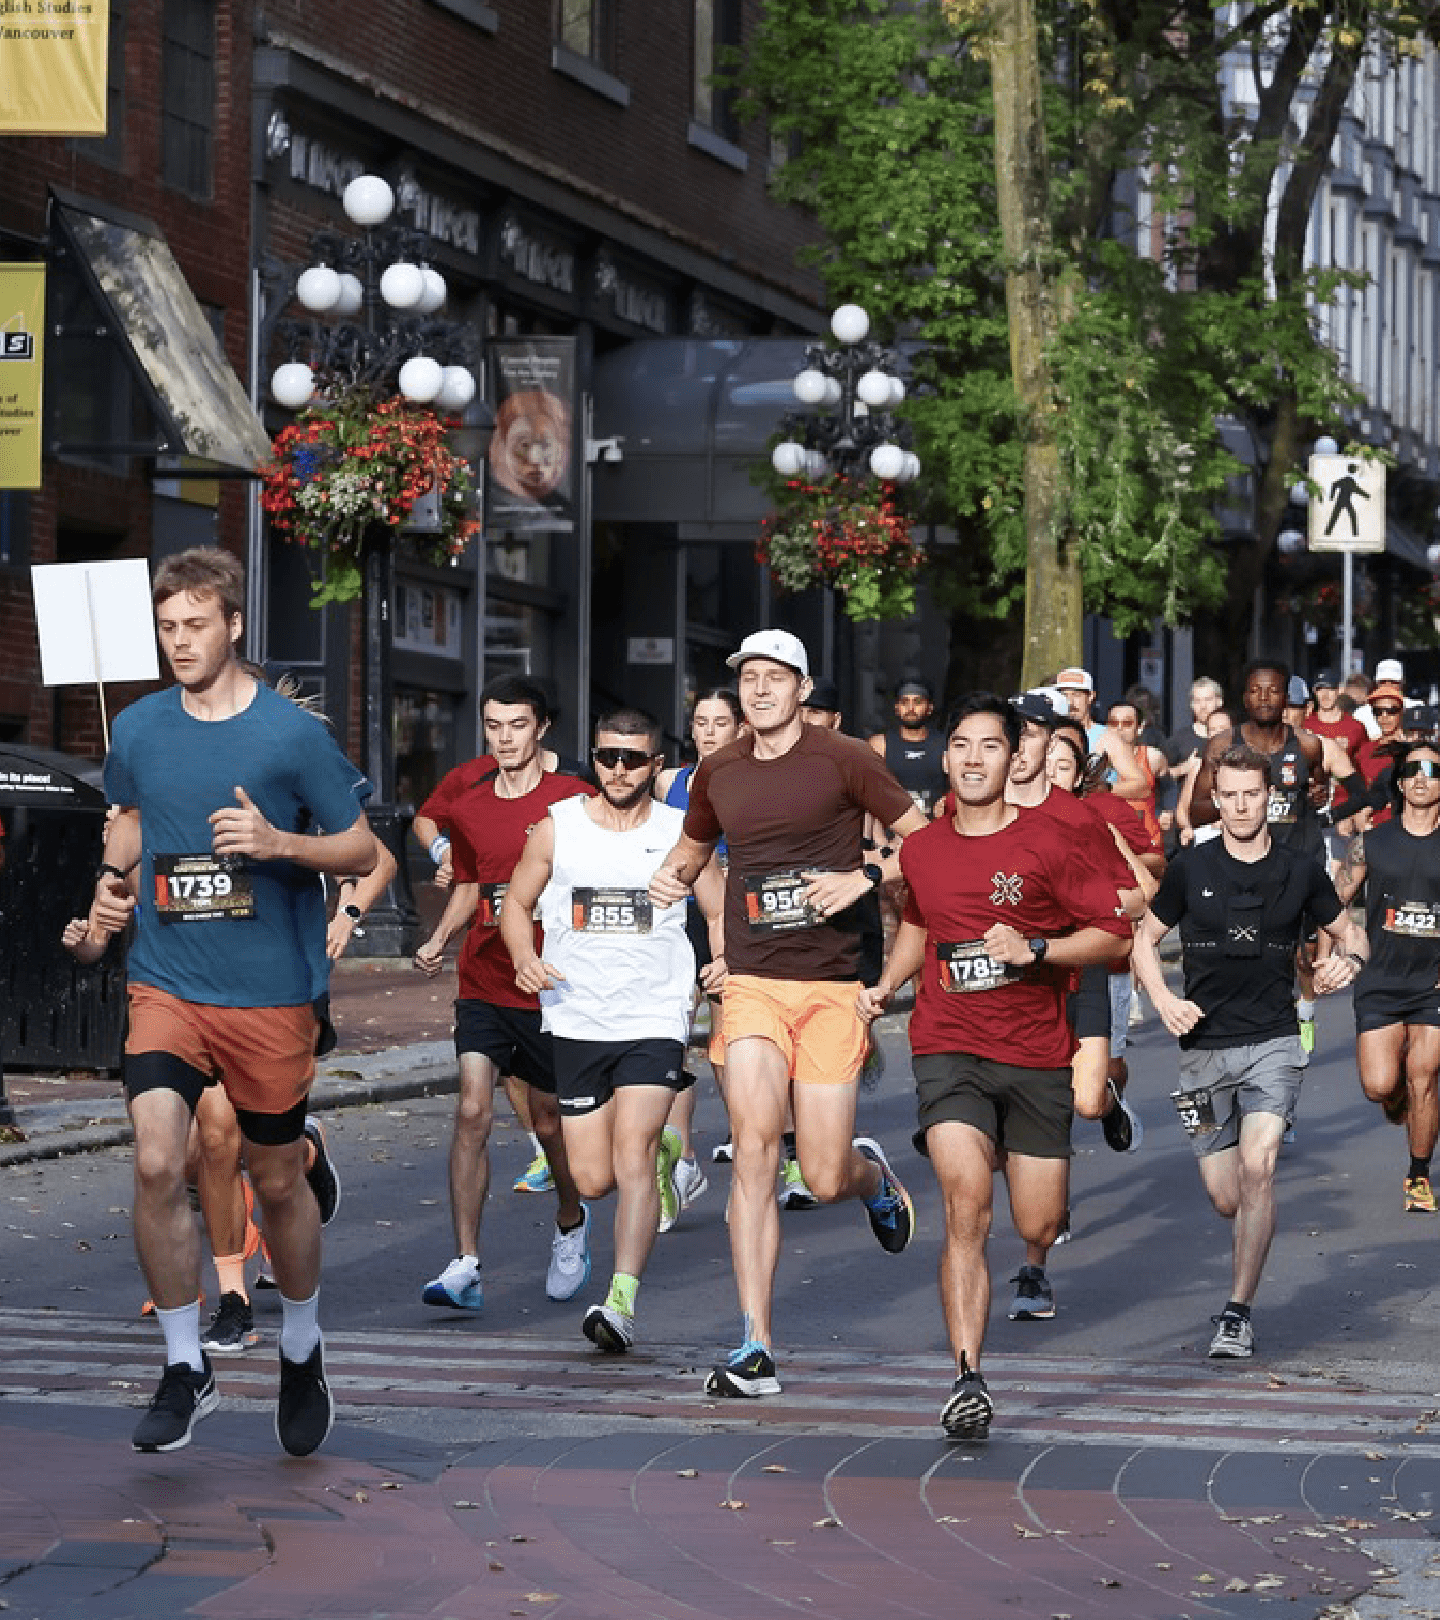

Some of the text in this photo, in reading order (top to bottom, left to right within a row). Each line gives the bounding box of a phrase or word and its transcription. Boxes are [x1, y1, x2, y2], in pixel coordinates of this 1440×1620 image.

[38, 0, 92, 13] Studies
[168, 873, 232, 899] 1739
[590, 906, 634, 924] 855
